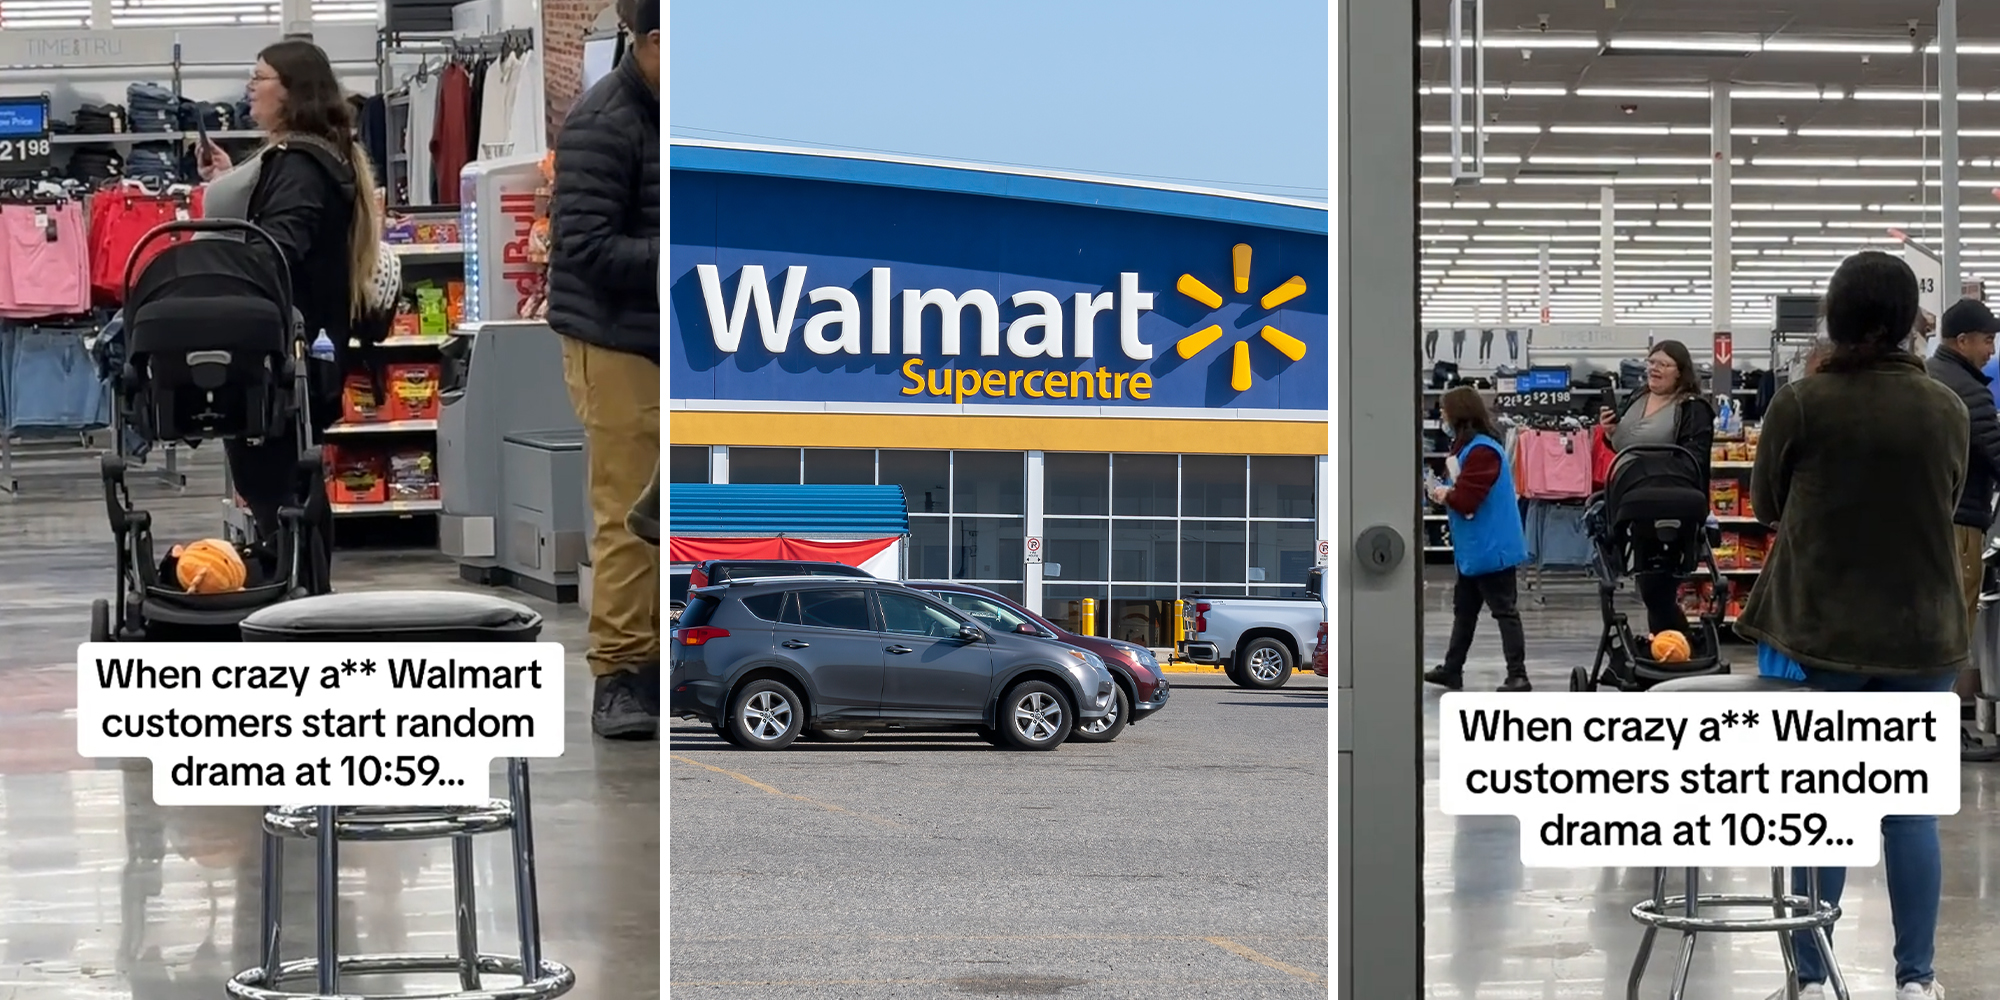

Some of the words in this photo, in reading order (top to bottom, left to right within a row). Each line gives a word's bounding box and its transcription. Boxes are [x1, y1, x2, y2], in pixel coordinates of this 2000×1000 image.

[501, 194, 536, 264] Bull
[697, 264, 1154, 360] Walmart
[902, 358, 1153, 404] Supercentre
